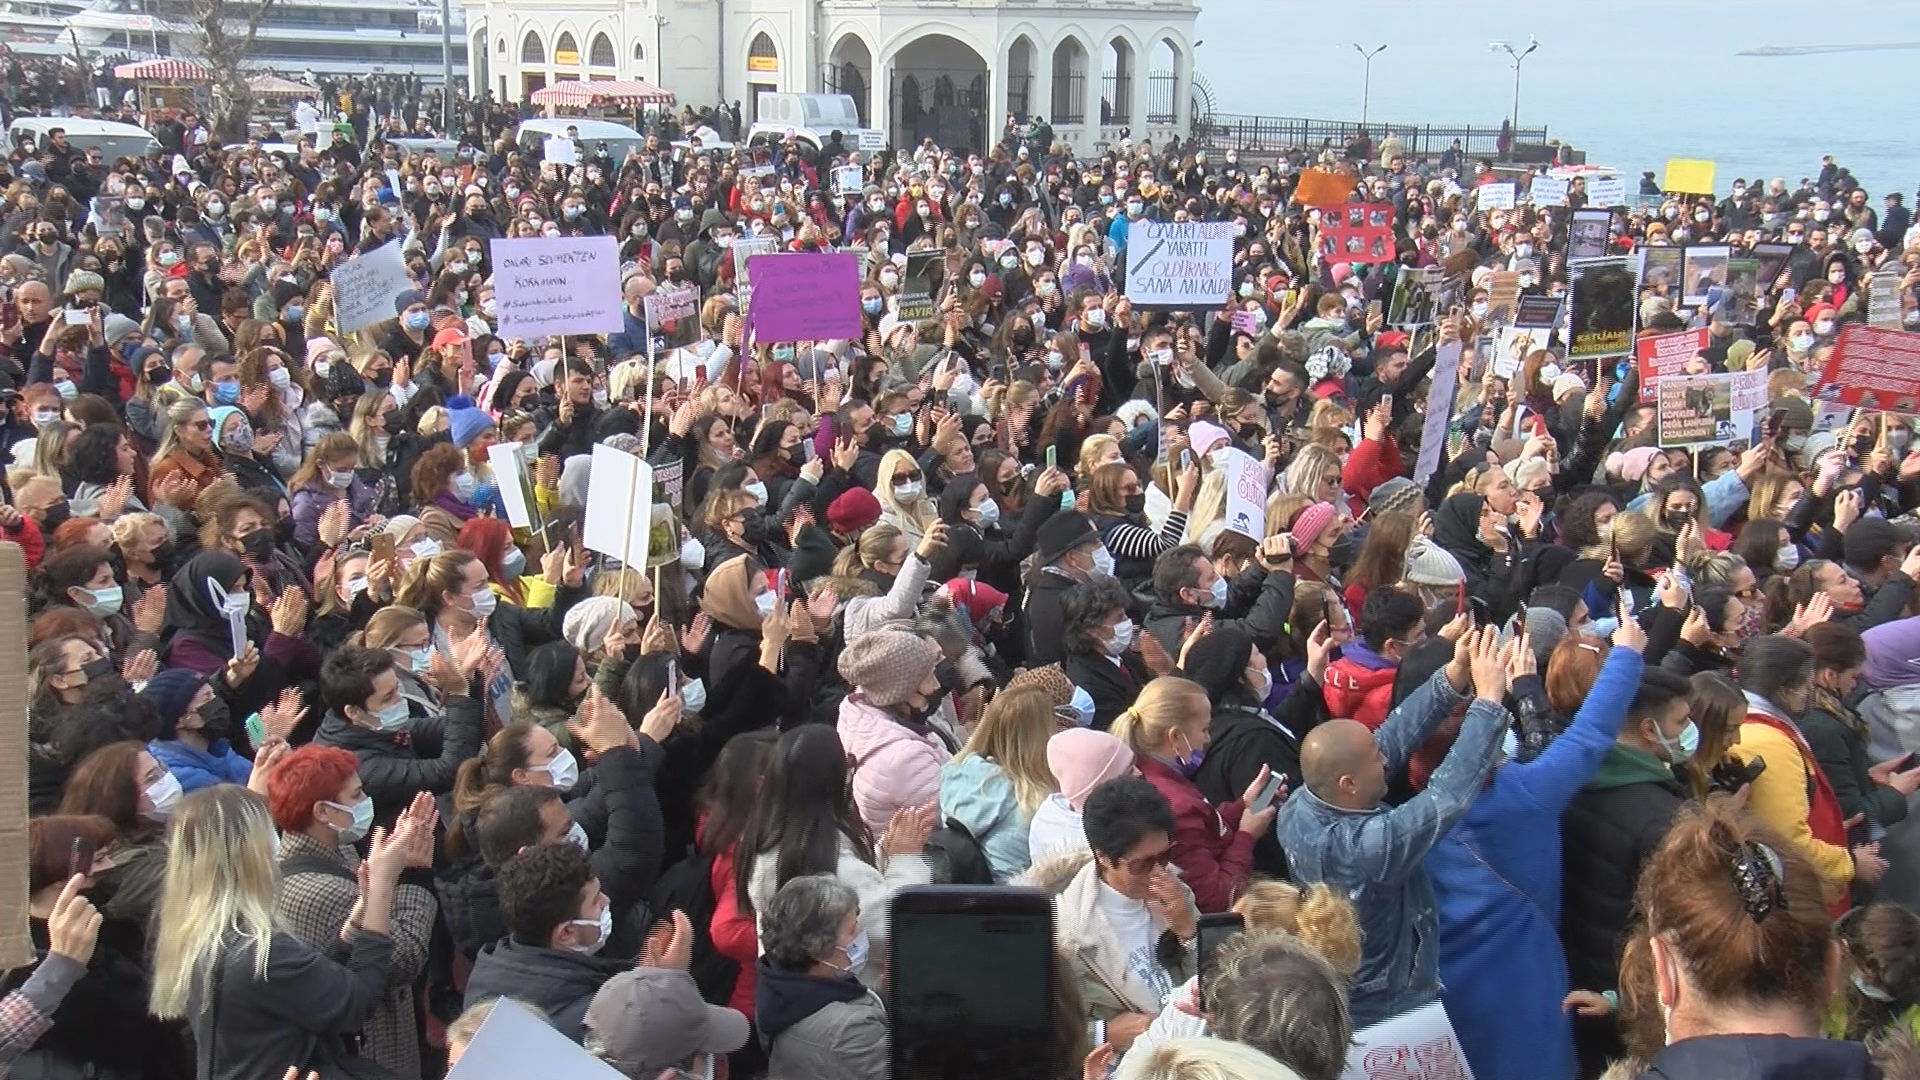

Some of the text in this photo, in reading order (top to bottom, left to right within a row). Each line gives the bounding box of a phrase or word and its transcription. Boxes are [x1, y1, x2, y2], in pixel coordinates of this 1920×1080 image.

[1146, 222, 1229, 241] ONLARI ALLAH
[1166, 241, 1209, 257] YARATTI
[1134, 277, 1173, 295] SANA
